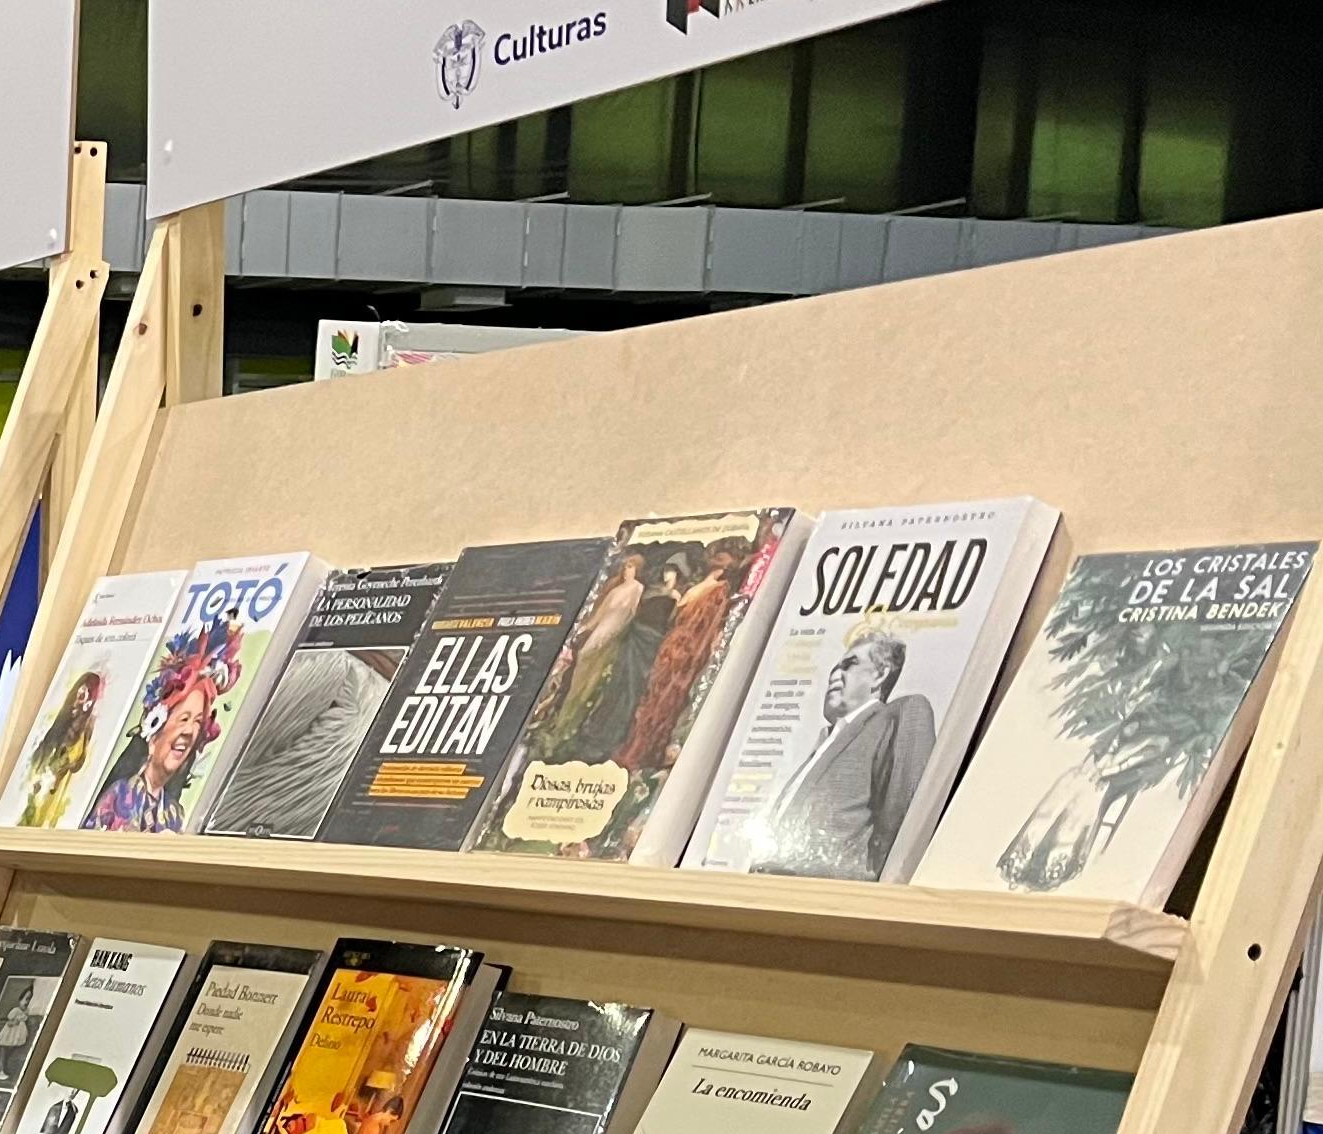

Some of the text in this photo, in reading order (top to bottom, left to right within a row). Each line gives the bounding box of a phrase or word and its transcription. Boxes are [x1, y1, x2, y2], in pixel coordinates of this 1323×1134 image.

[494, 12, 606, 65] Culturas
[800, 538, 987, 616] SOLEDAD
[1143, 551, 1308, 578] LOS CRISTALES
[182, 562, 288, 624] TOTÓ
[316, 594, 411, 611] LA PERSONALIDAD
[1128, 573, 1290, 605] DE LA SAL
[310, 611, 403, 628] DE LOS PELÍCANOS
[1118, 602, 1282, 623] CRISTINA BENDEK
[414, 634, 533, 695] ELLAS
[379, 695, 511, 755] EDITAN
[571, 775, 616, 794] brujas
[108, 953, 133, 972] KANG
[206, 982, 237, 1000] Piedad
[331, 982, 366, 1004] Laura
[321, 1006, 376, 1031] Restrepo
[490, 1007, 579, 1030] Silvana Paternostro
[480, 1029, 623, 1064] EN LA TIERRA DE DIOS
[473, 1048, 568, 1076] Y DEL HOMBRE
[698, 1046, 842, 1076] MARGARITA GARCÍA ROBAYO
[691, 1077, 813, 1112] La encomienda
